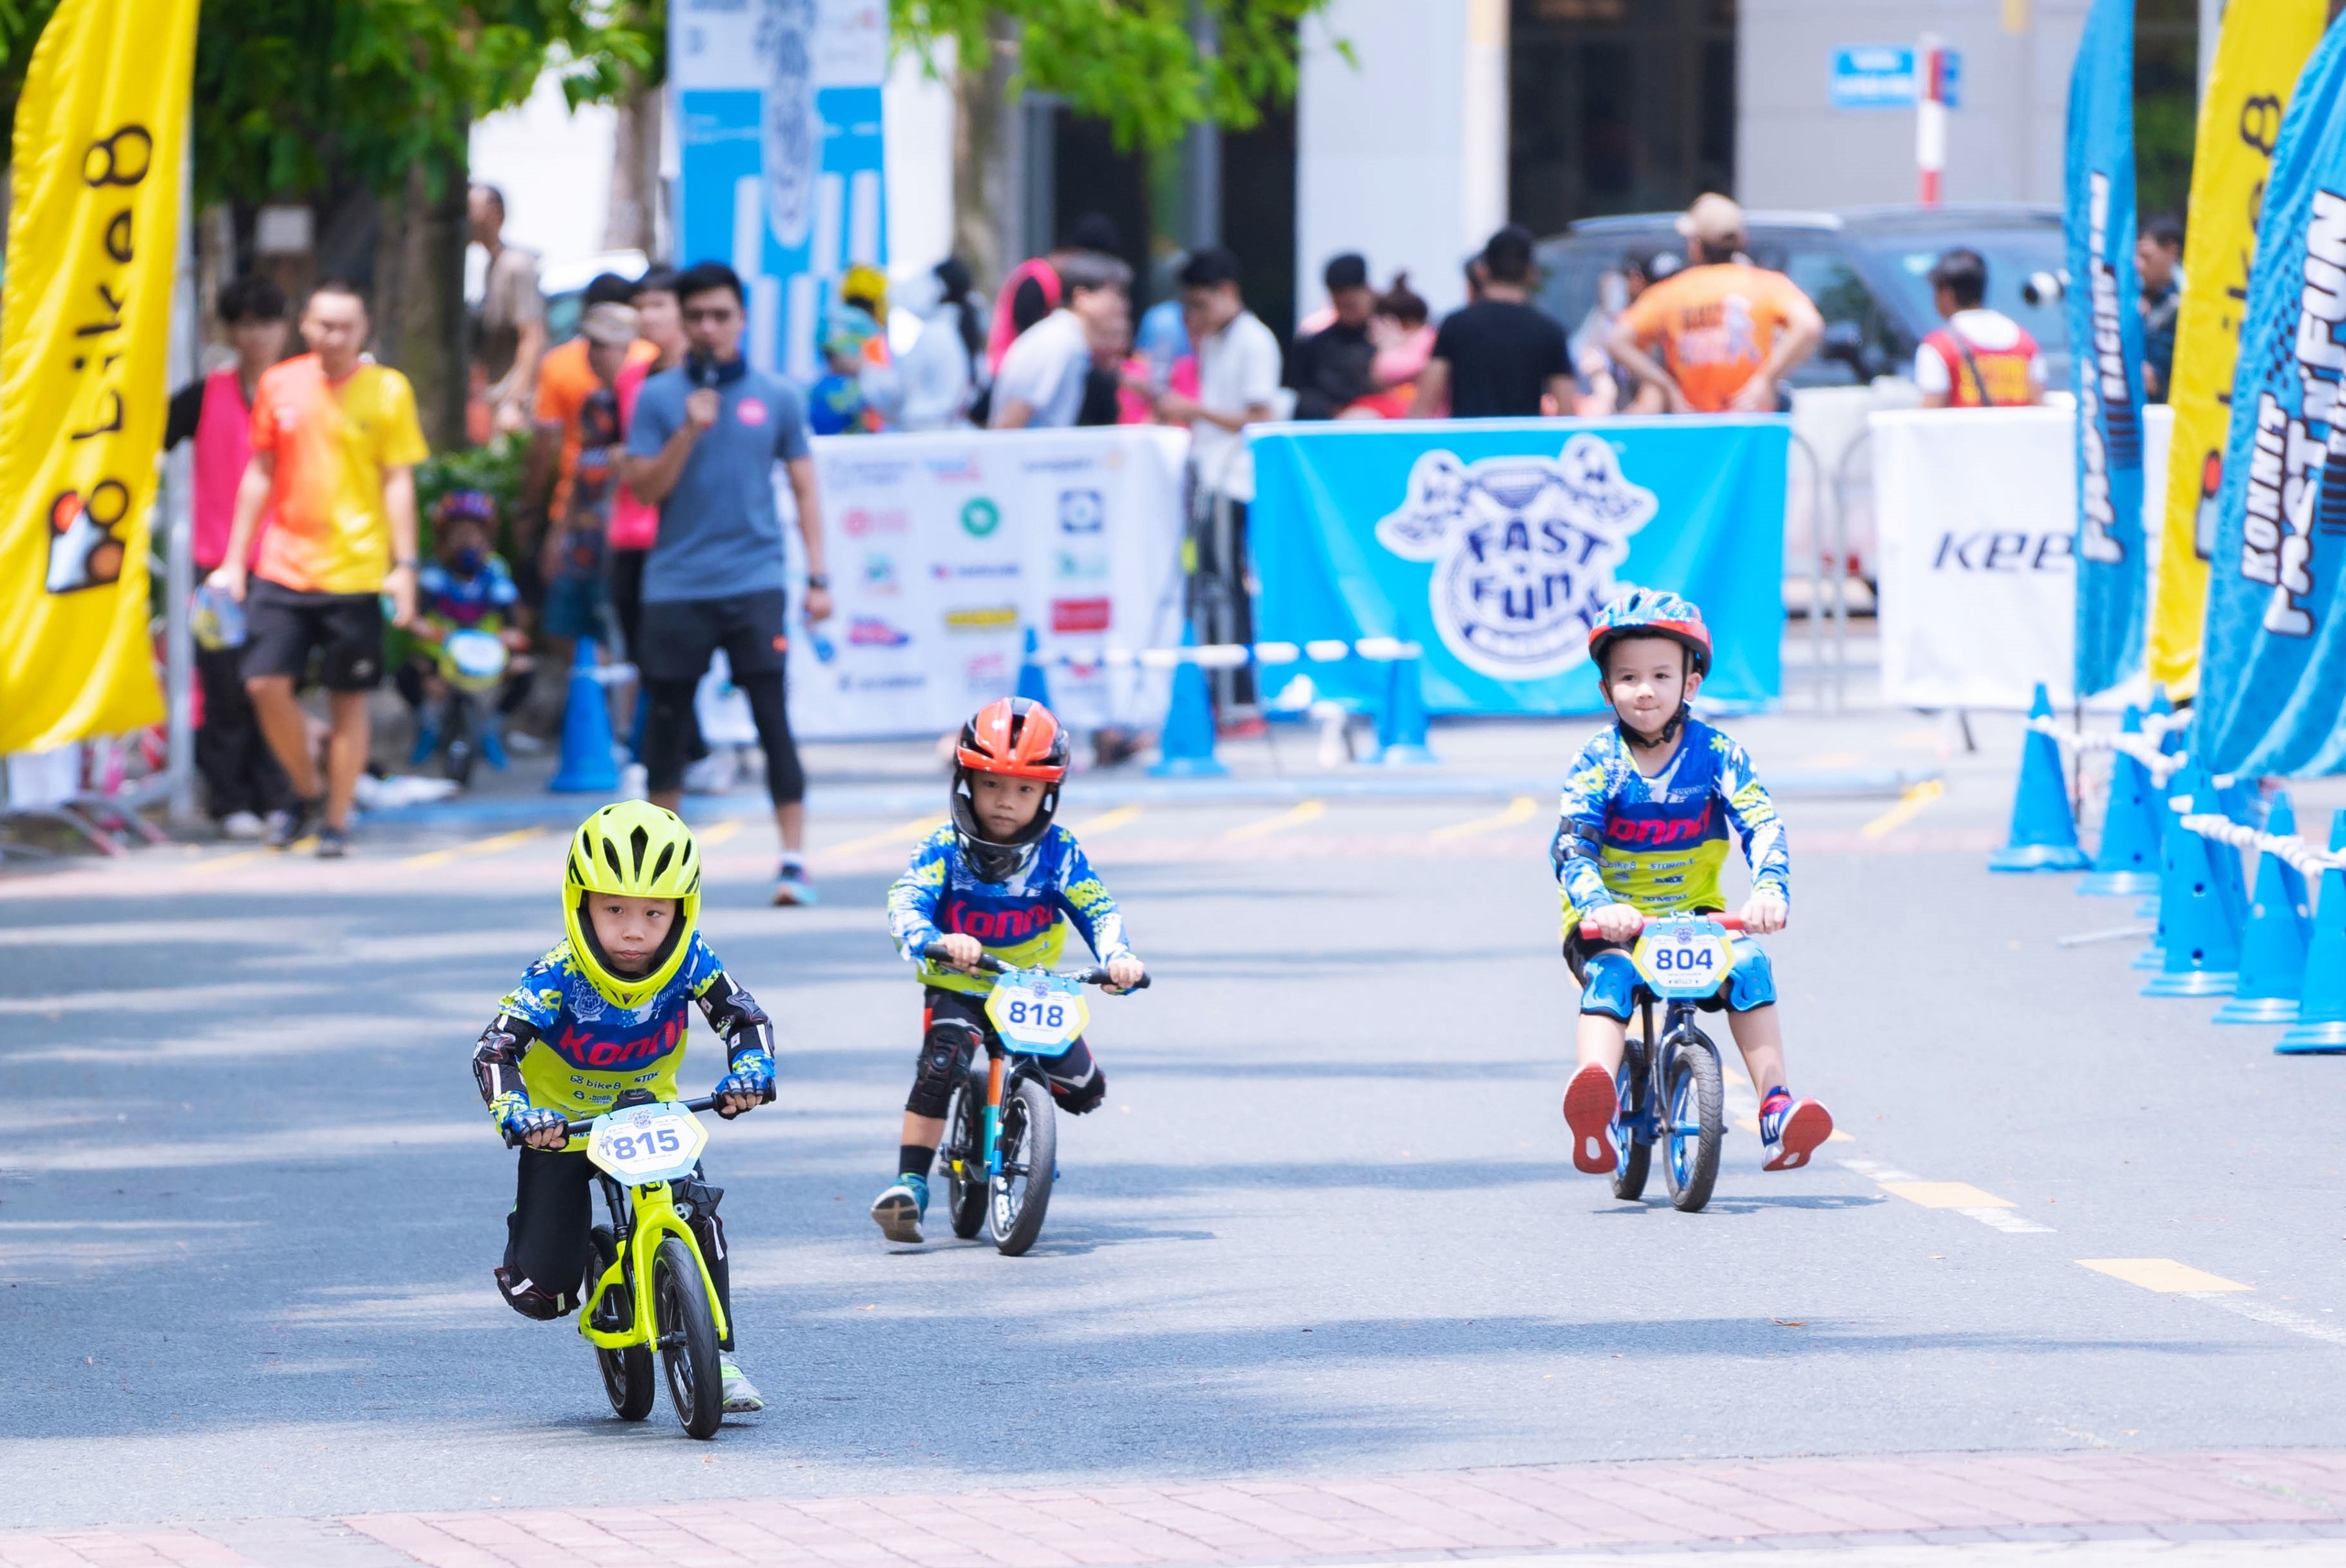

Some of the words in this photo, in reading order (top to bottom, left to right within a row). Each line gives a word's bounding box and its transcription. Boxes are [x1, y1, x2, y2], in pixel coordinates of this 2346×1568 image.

[2242, 391, 2289, 587] KONNIT
[1469, 520, 1610, 563] FAST
[1656, 948, 1714, 970] 804
[1009, 1001, 1064, 1027] 818
[586, 1080, 621, 1090] bike8
[613, 1129, 680, 1160] 815
